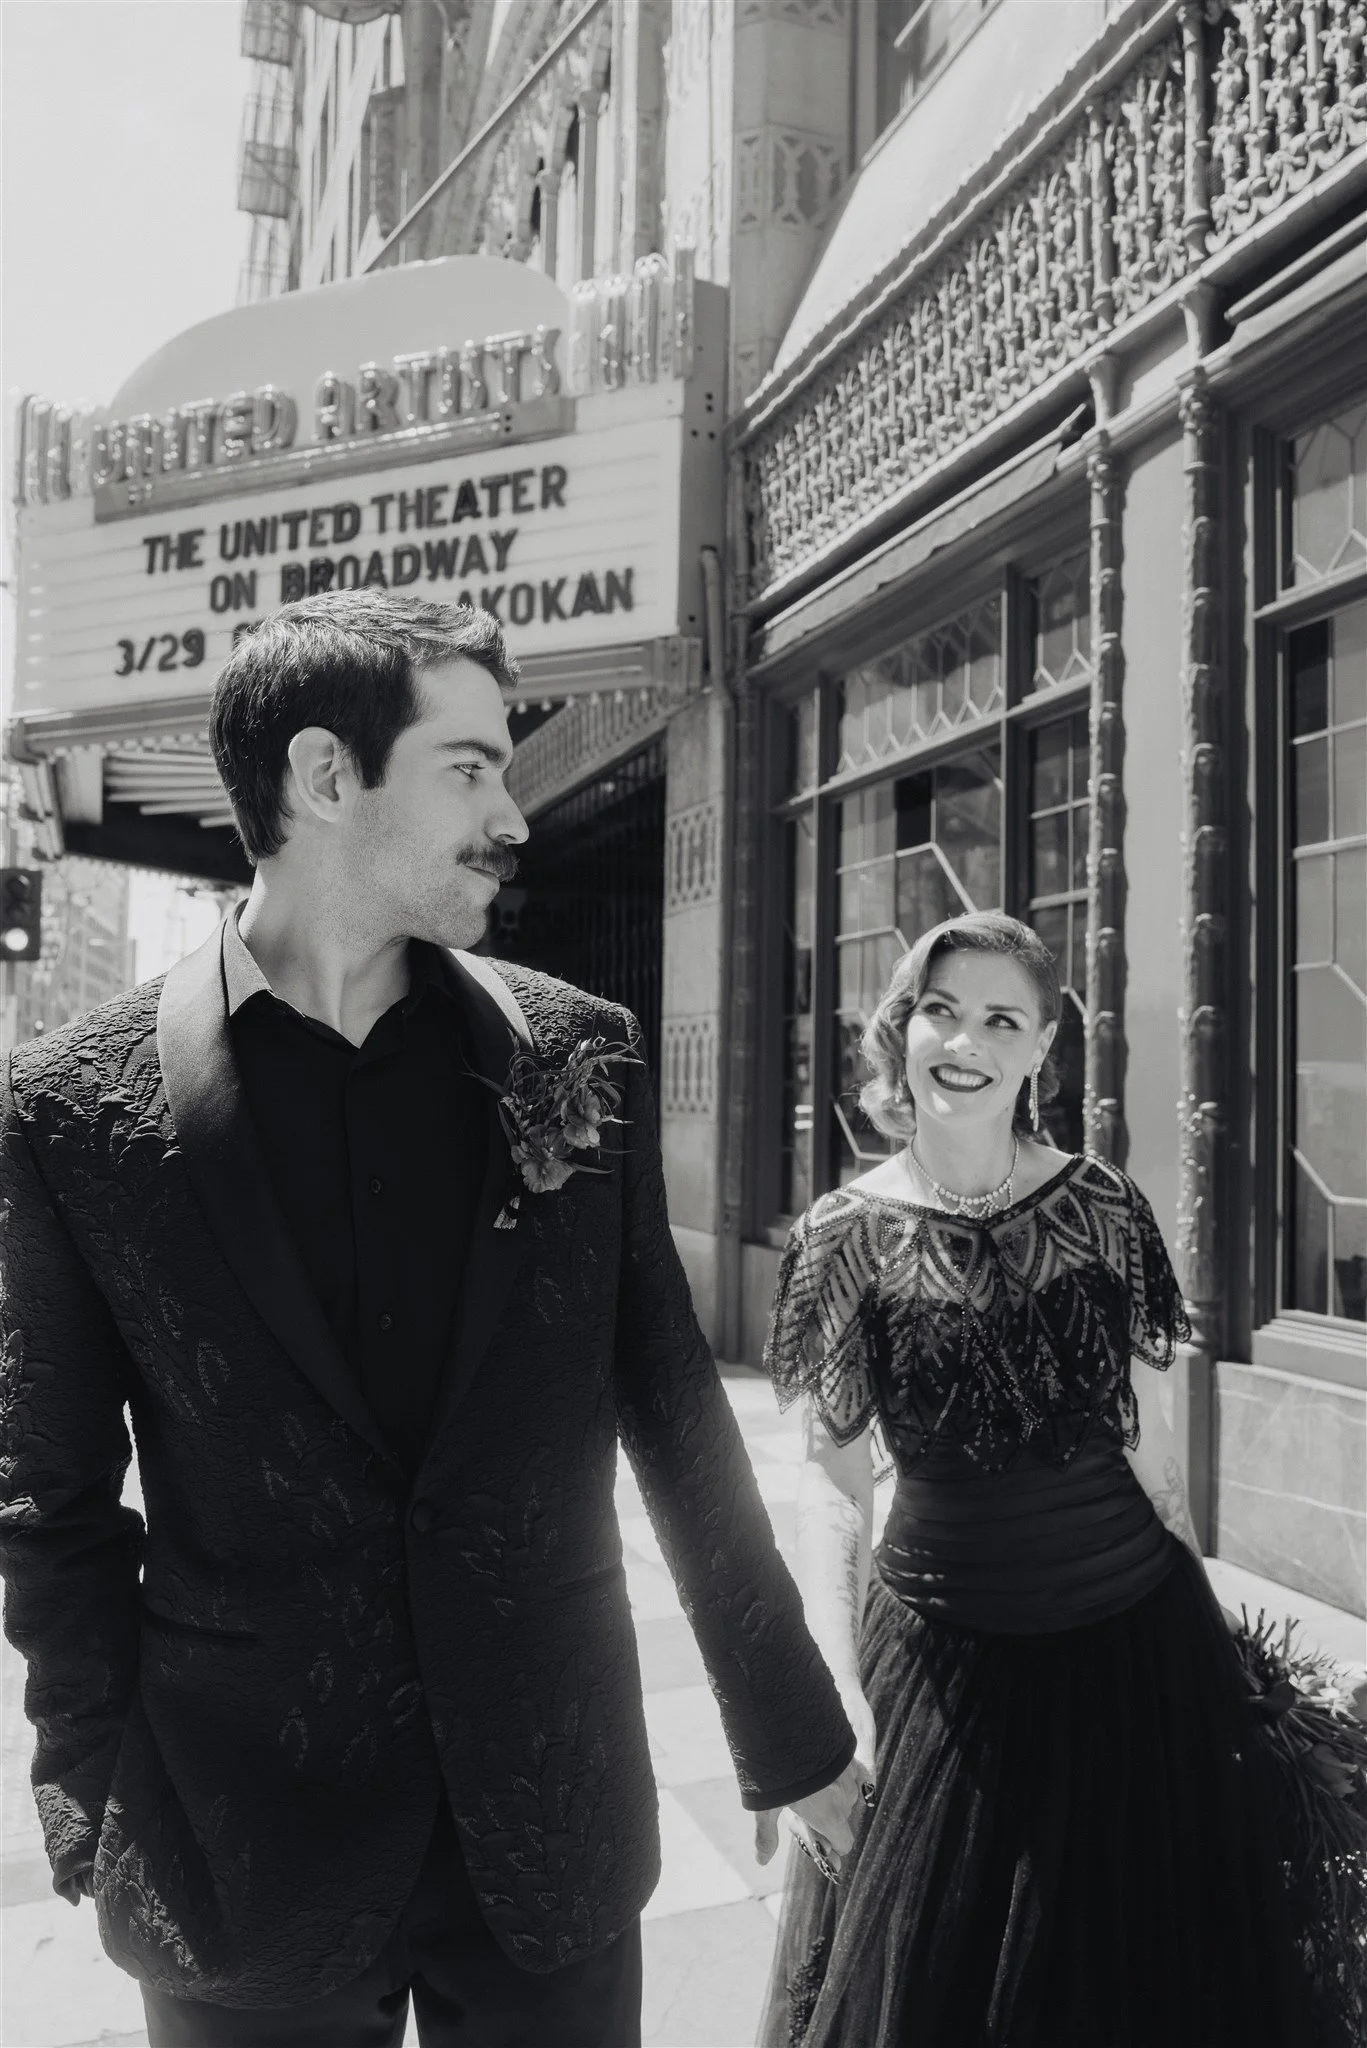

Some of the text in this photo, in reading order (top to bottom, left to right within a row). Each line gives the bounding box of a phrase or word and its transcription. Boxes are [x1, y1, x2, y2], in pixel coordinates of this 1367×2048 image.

[91, 325, 561, 487] UNITED ARTISTS
[143, 464, 568, 575] THE UNITED THEATER
[209, 528, 518, 613] ON BROADWAY
[115, 628, 205, 676] 3/29
